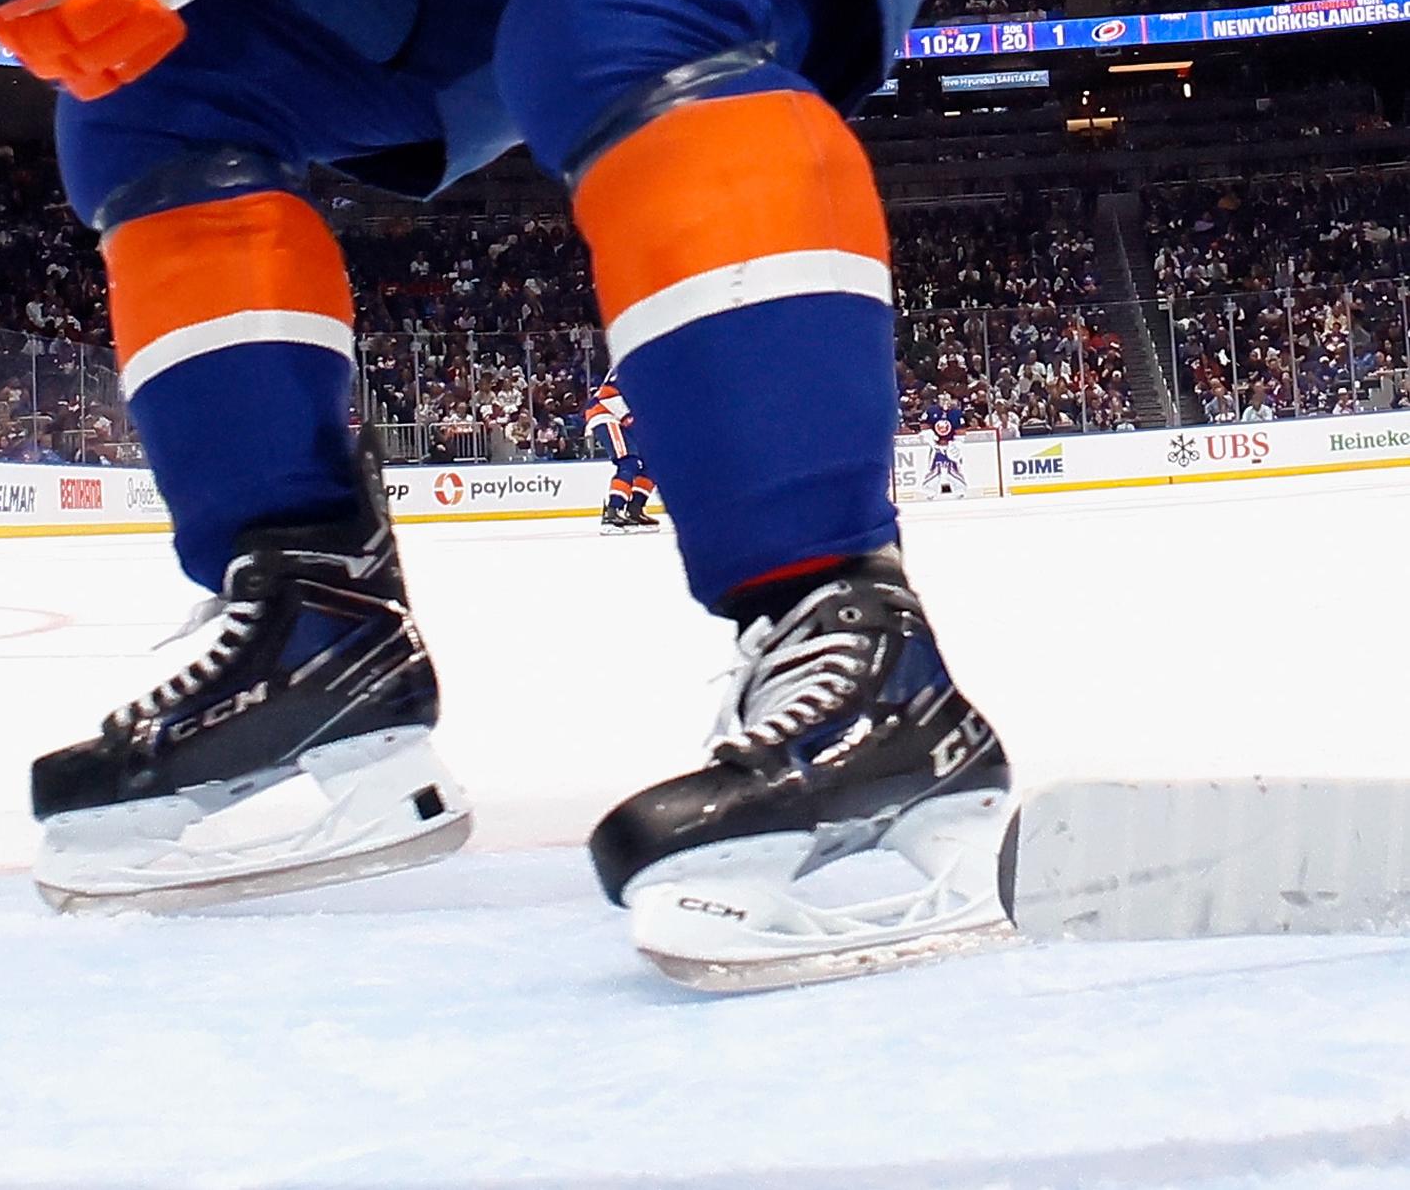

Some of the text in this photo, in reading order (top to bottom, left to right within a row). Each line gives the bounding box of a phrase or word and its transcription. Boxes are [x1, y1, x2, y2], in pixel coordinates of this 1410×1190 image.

[920, 32, 981, 55] 10:47
[1001, 34, 1027, 50] 20
[1053, 24, 1065, 47] 1
[1205, 431, 1271, 461] UBS
[1012, 457, 1064, 476] DIME
[469, 473, 562, 500] paylocity
[166, 680, 269, 743] CCM
[678, 896, 746, 922] CCM
